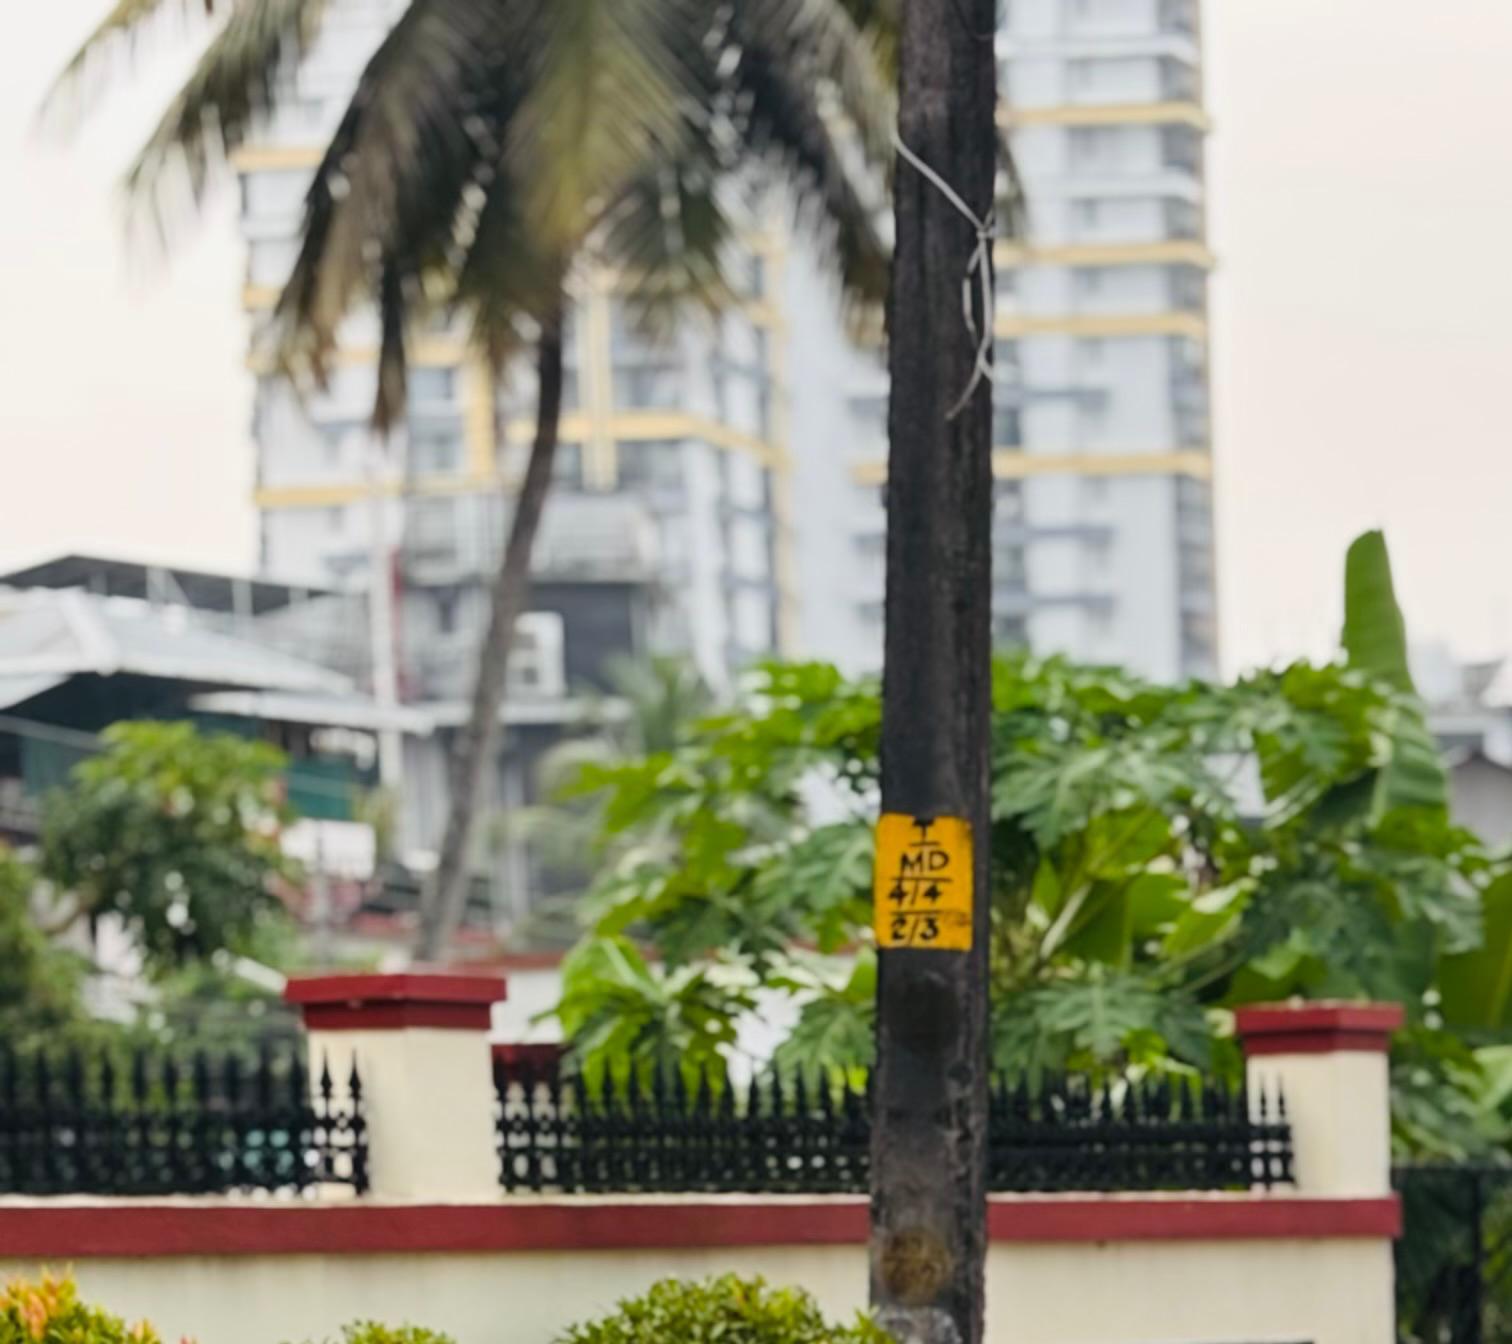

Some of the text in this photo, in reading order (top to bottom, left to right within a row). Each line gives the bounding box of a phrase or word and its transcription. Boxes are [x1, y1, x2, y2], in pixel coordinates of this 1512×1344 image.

[901, 851, 950, 873] MD
[889, 880, 943, 905] 4/4
[891, 914, 940, 945] 2/3
